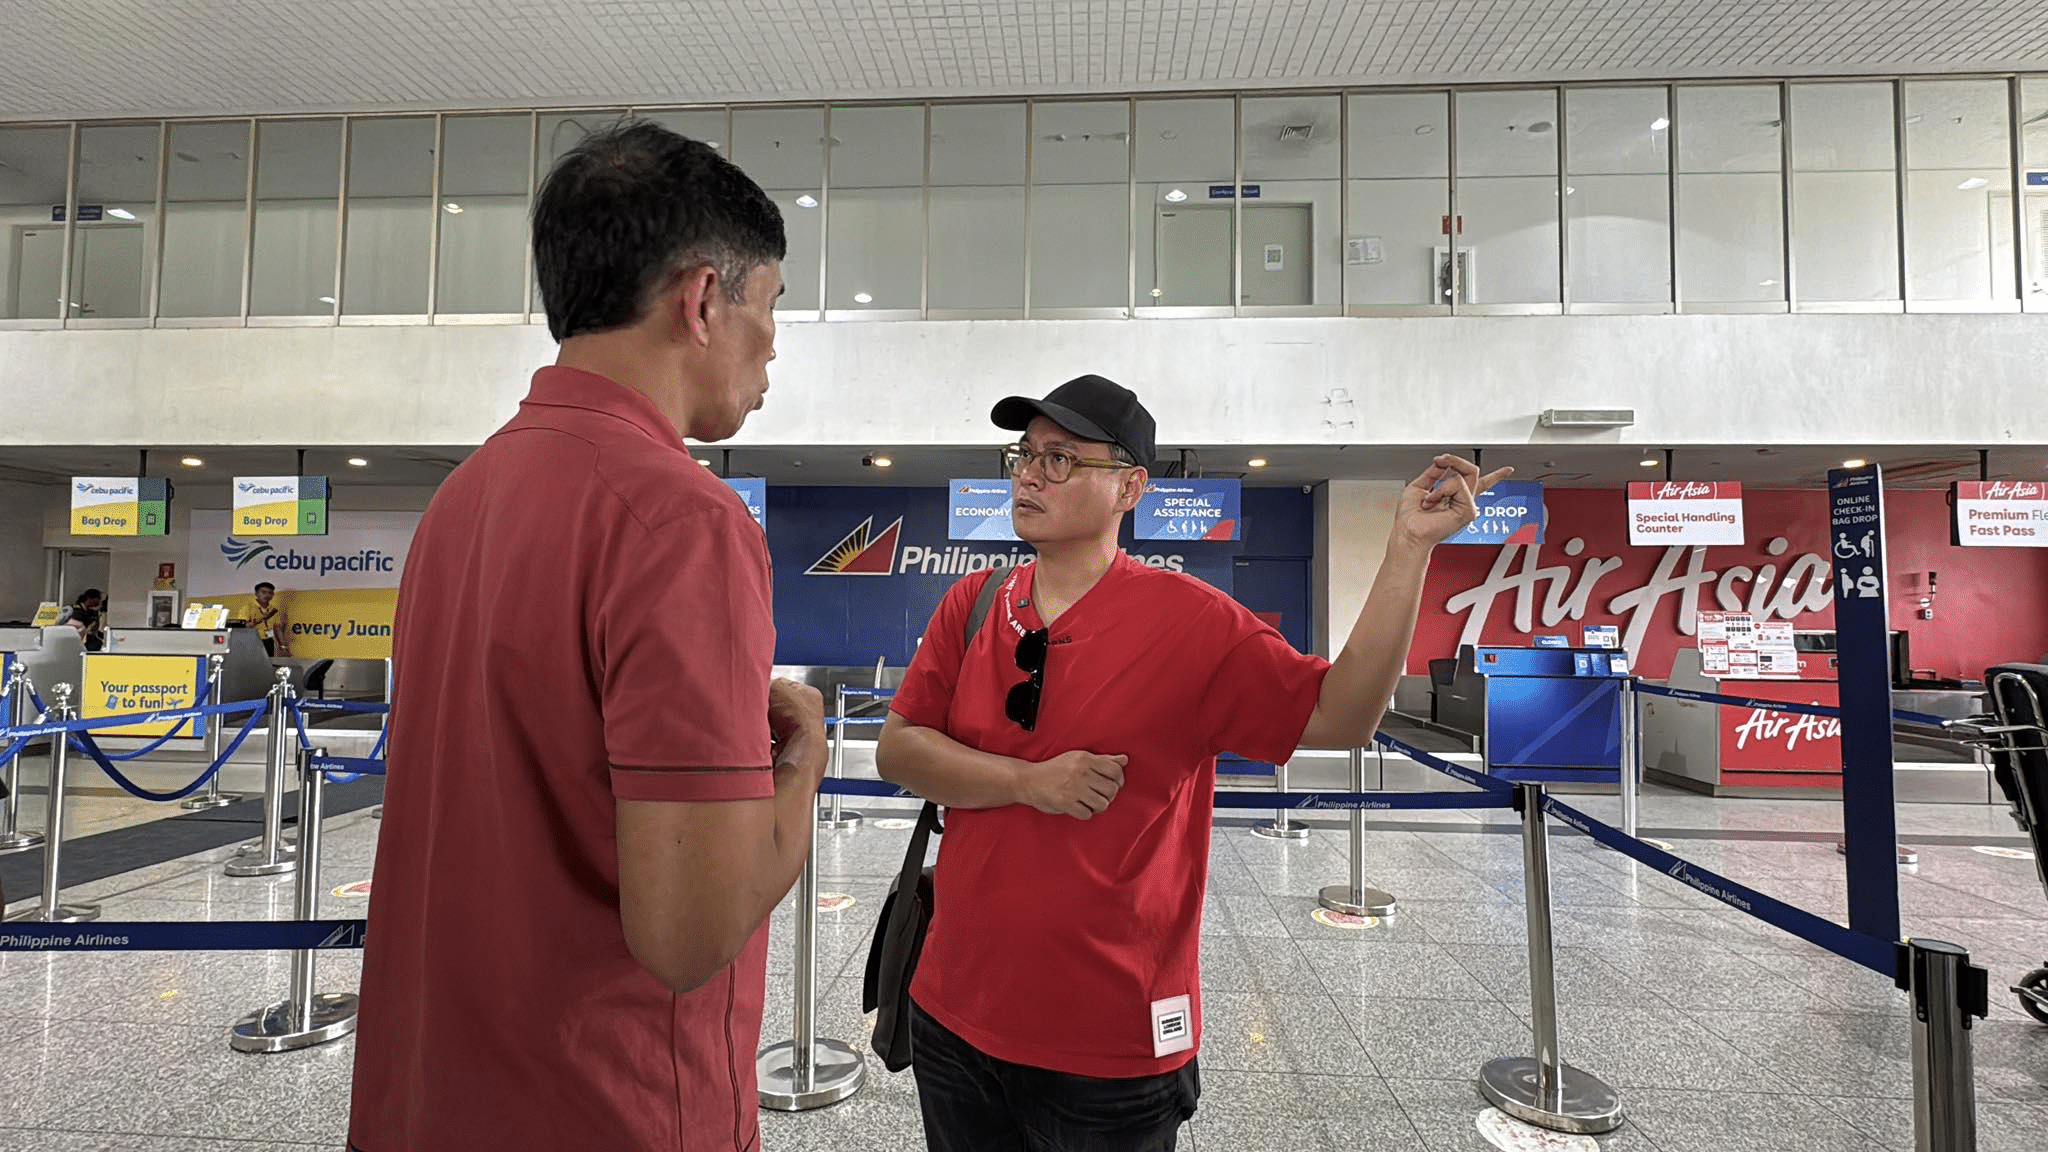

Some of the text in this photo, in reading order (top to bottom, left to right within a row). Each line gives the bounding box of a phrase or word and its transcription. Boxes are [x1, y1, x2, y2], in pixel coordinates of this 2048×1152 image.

[109, 487, 133, 495] pacific
[253, 486, 293, 495] cebu pacific
[1164, 498, 1211, 507] SPECIAL
[1836, 494, 1870, 506] ONLINE
[955, 507, 1012, 517] ECONOMY
[1153, 508, 1222, 518] ASSISTANCE
[1484, 506, 1528, 518] DROP
[1833, 504, 1876, 516] CHECK-IN
[1968, 508, 2048, 521] Premium Fle
[82, 516, 127, 528] Bag Drop
[243, 516, 288, 527] Bag Drop
[1636, 511, 1736, 524] Special Handling
[1832, 514, 1878, 526] BAG DROP
[1636, 524, 1684, 534] Counter
[1970, 525, 2036, 537] Fast Pass
[264, 549, 393, 576] cebu pacific
[292, 620, 391, 639] every Juan
[101, 681, 188, 696] Your passport
[122, 697, 136, 708] to
[1317, 801, 1391, 809] Philippine Airlines
[1686, 873, 1751, 911] Philippine Airlines
[0, 934, 130, 949] Philippine Airlines
